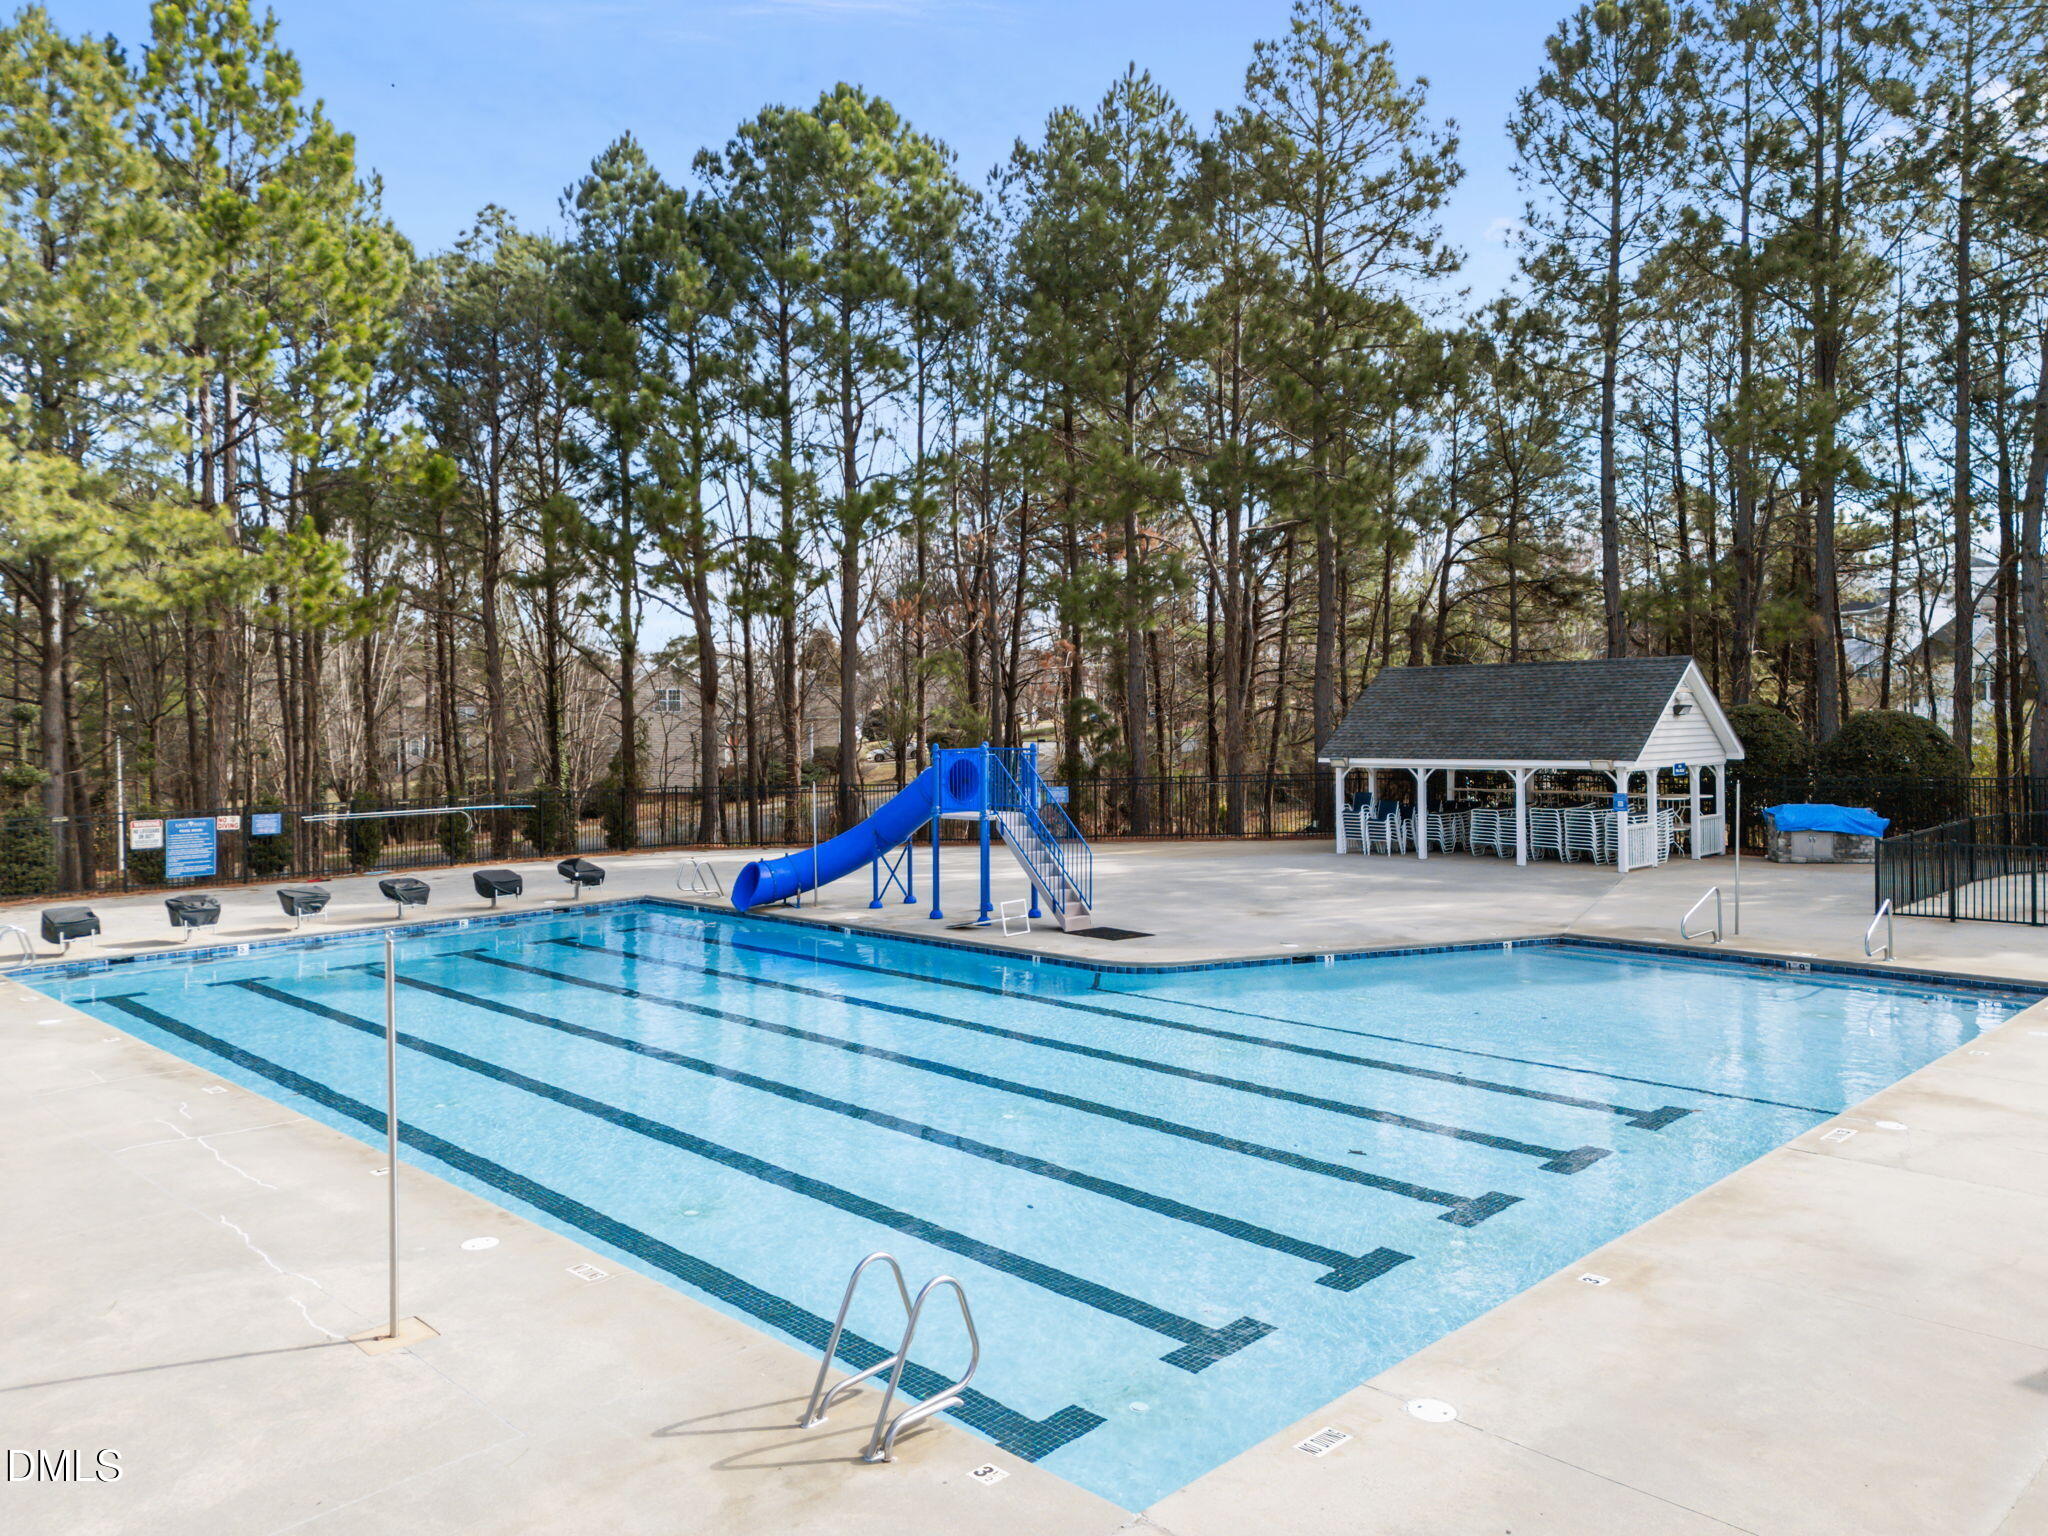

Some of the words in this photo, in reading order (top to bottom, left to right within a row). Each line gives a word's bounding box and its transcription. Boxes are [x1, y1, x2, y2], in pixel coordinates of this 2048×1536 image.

[1298, 1443, 1322, 1456] NO
[1310, 1429, 1346, 1448] DIVING
[973, 1466, 994, 1477] 3
